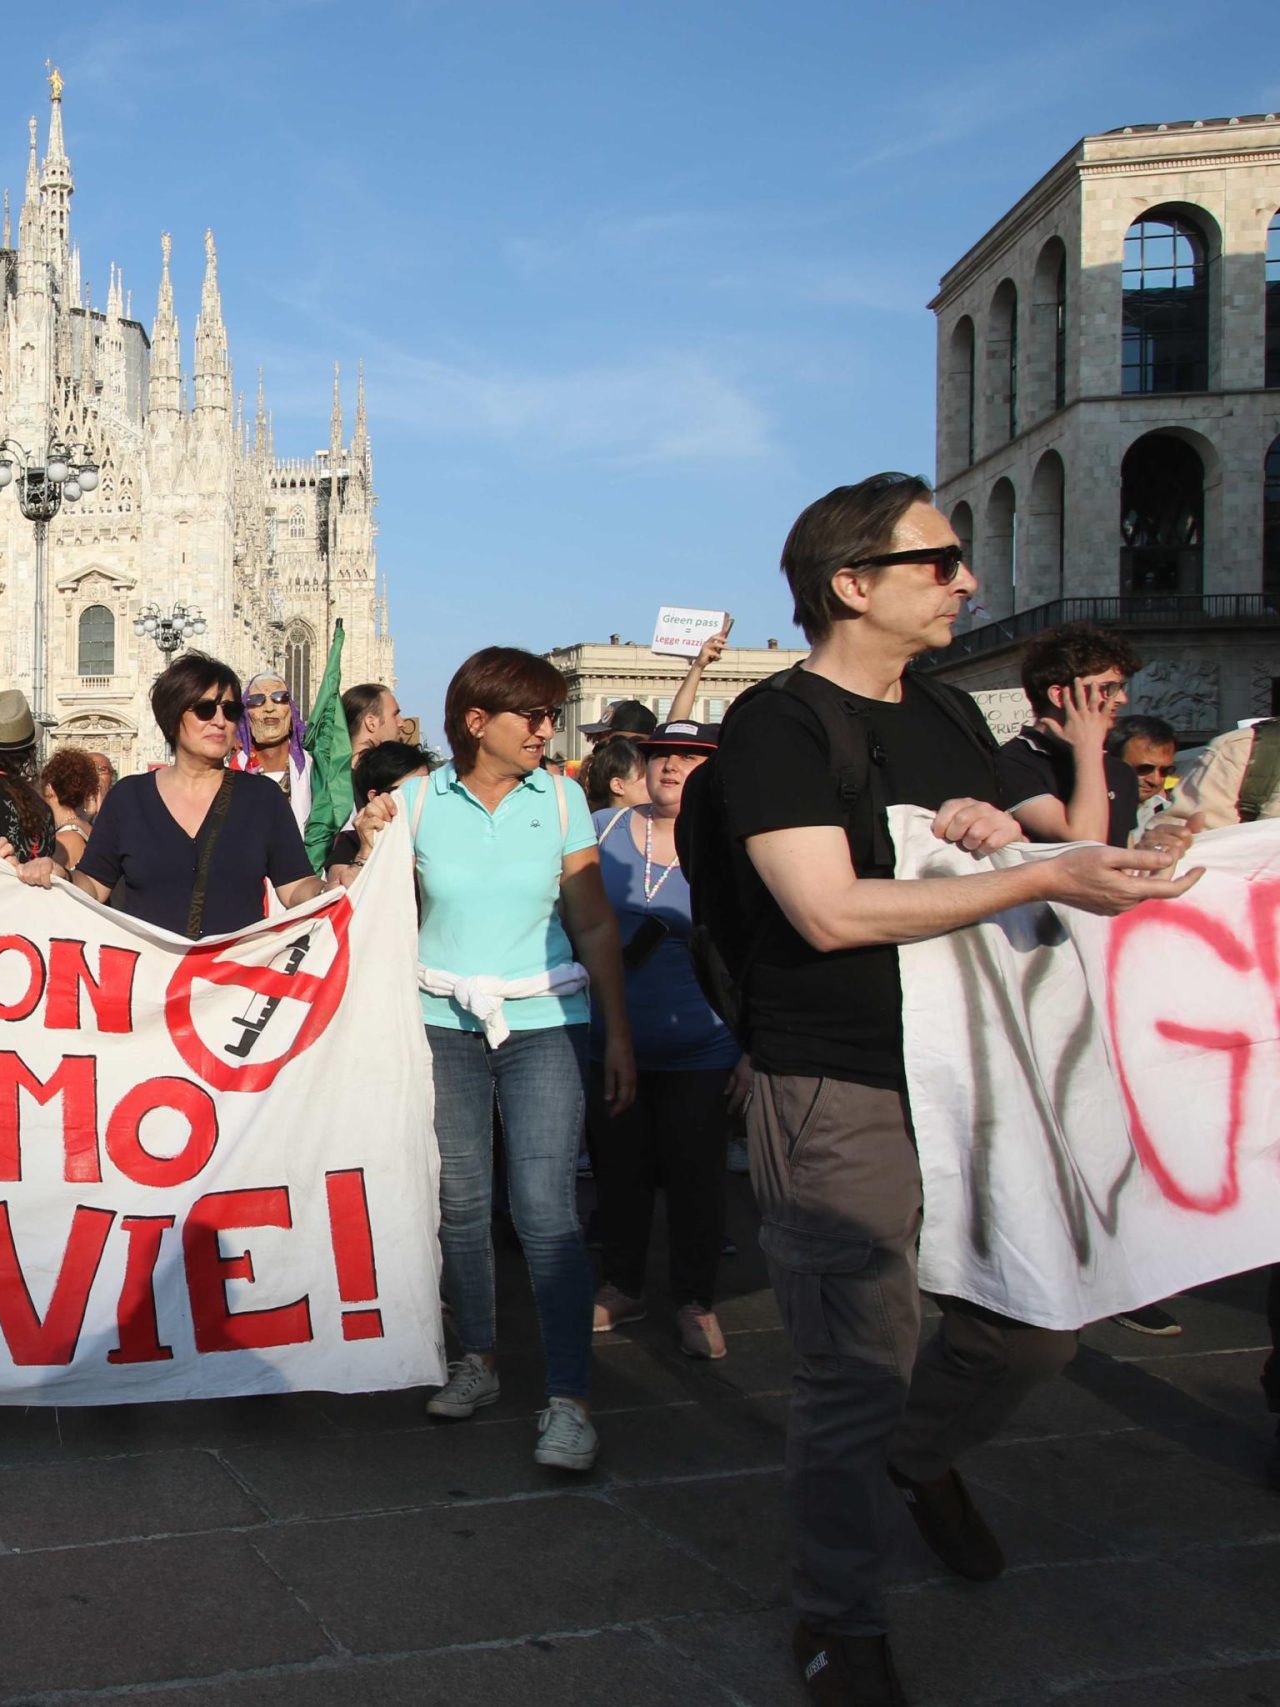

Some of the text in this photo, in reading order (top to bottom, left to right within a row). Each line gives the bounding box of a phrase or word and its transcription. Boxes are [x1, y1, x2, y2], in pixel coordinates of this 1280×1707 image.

[663, 614, 719, 628] Green pass
[655, 635, 706, 647] Legge razzi
